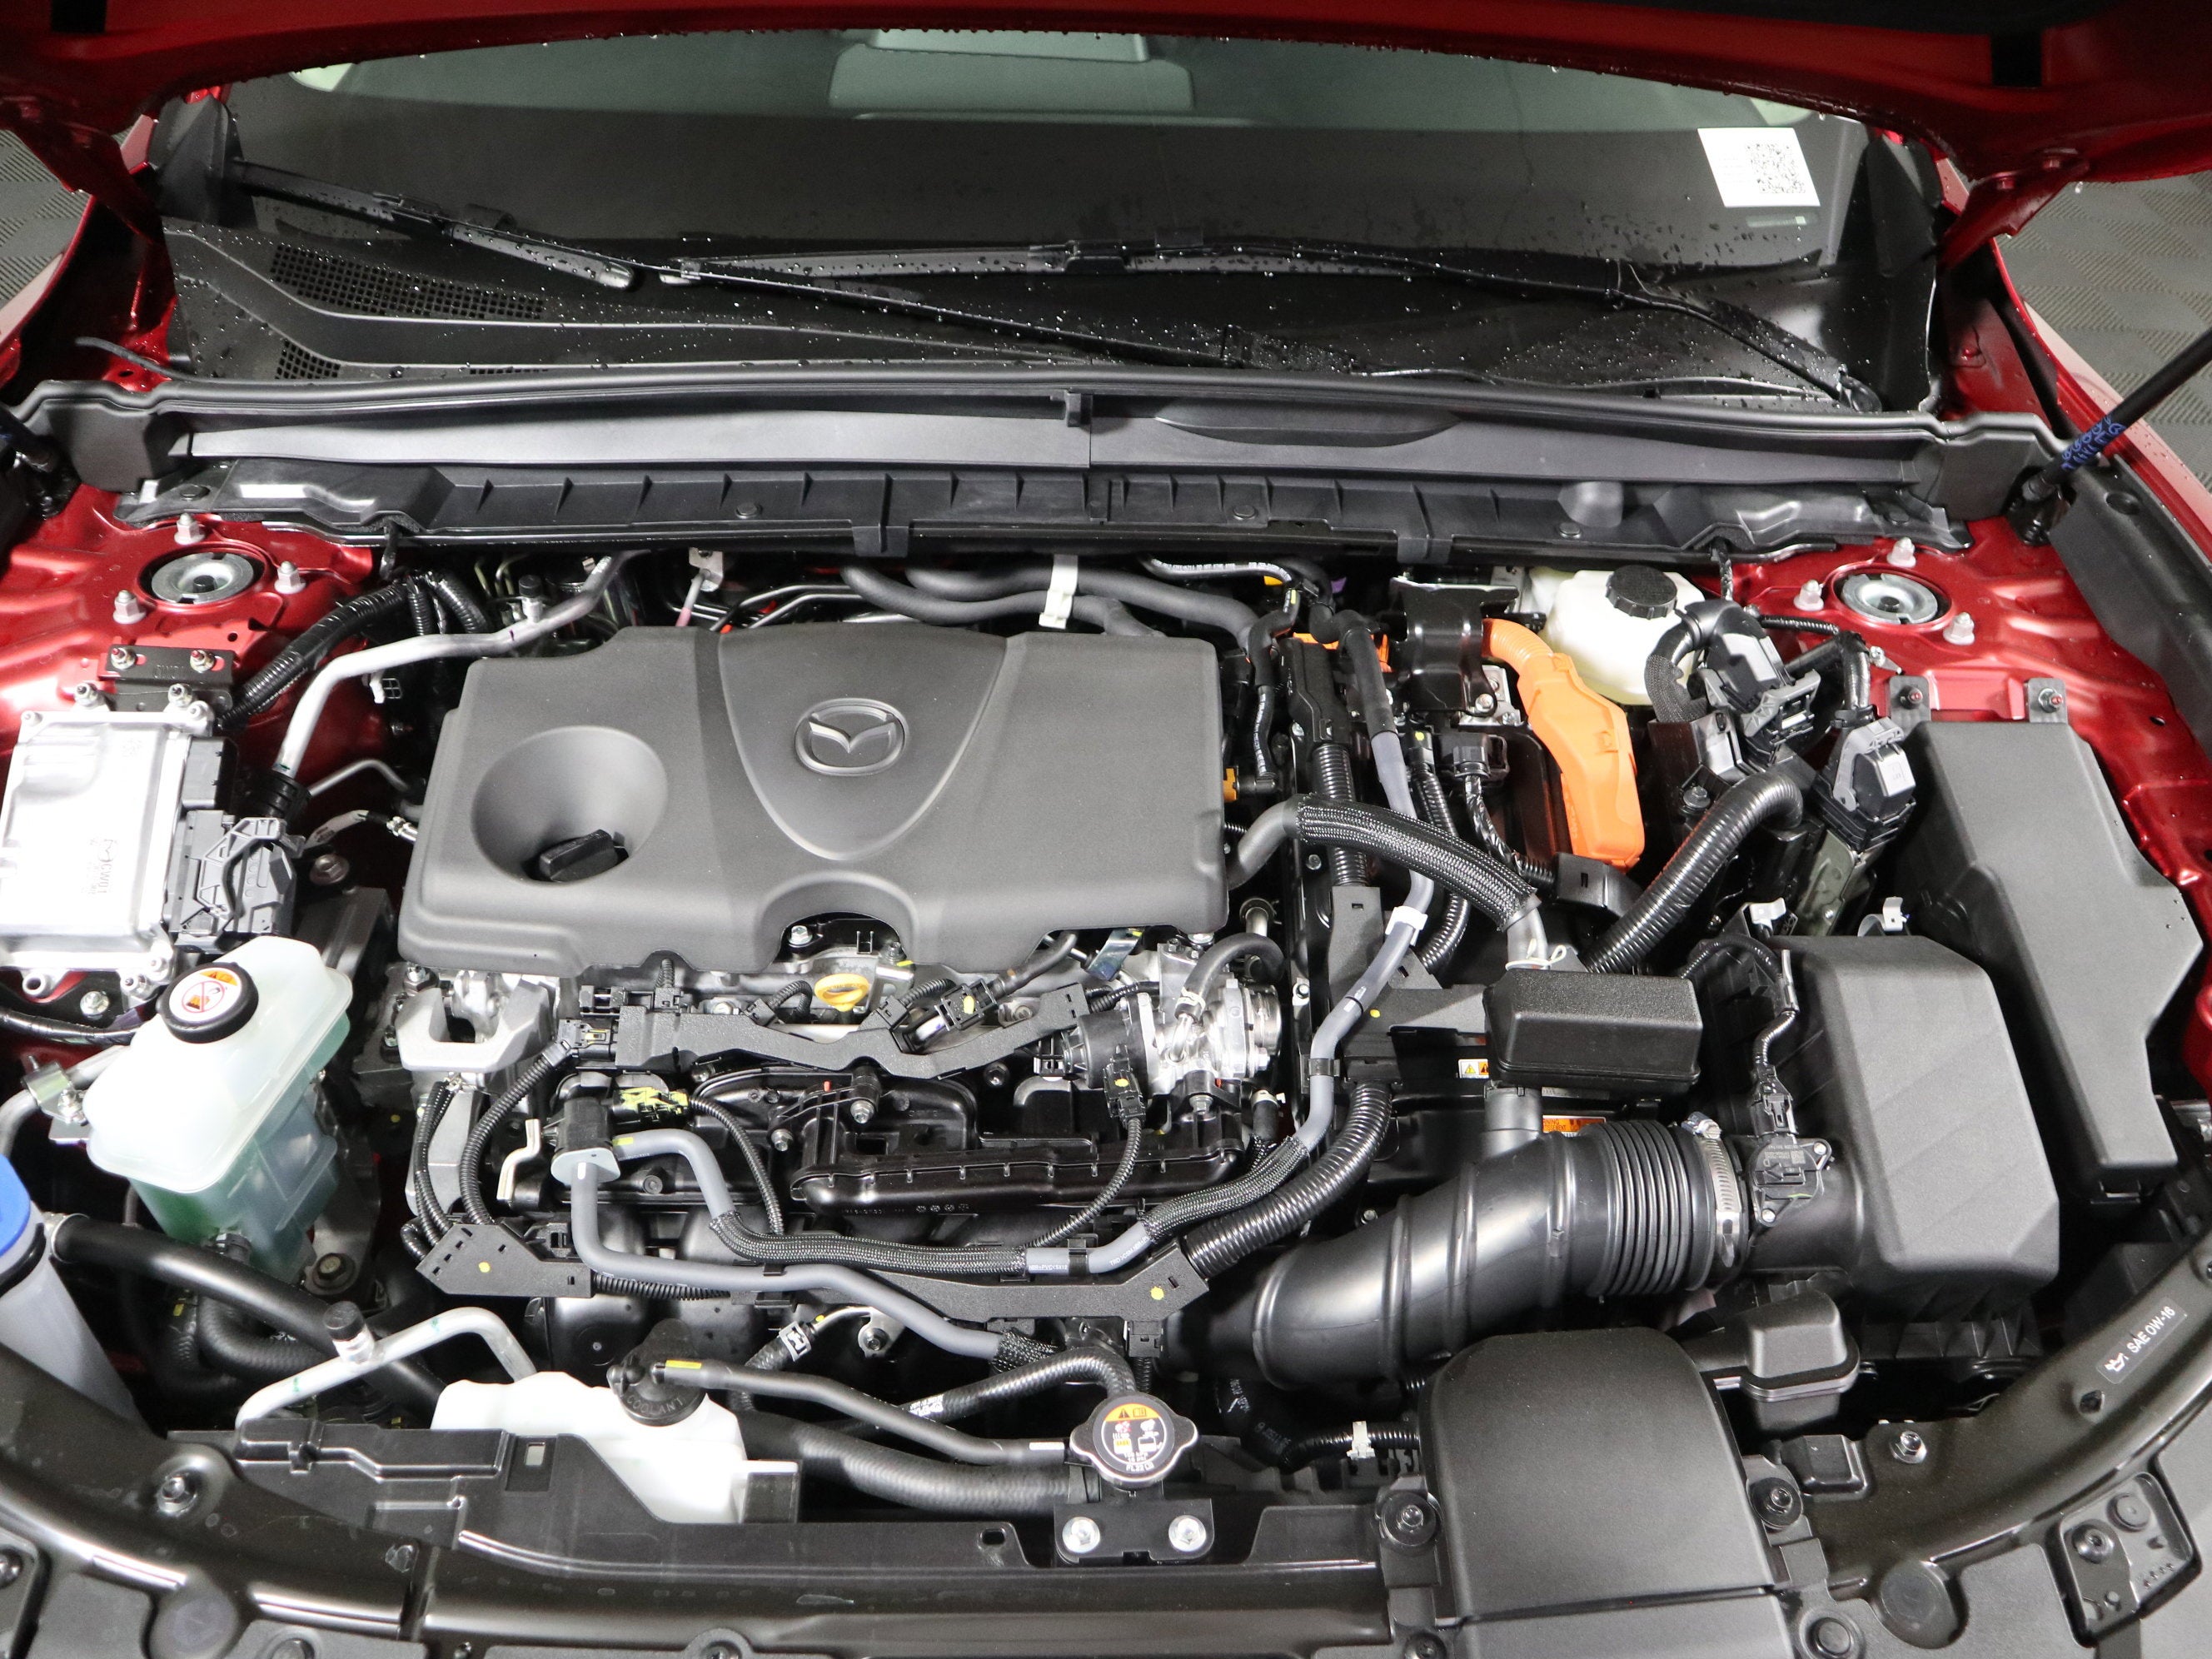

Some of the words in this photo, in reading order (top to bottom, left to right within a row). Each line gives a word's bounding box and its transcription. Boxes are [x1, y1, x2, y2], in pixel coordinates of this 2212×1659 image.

[2126, 1334, 2151, 1353] SAE
[2145, 1306, 2175, 1336] 0W-16
[626, 1395, 685, 1415] COOLANT
